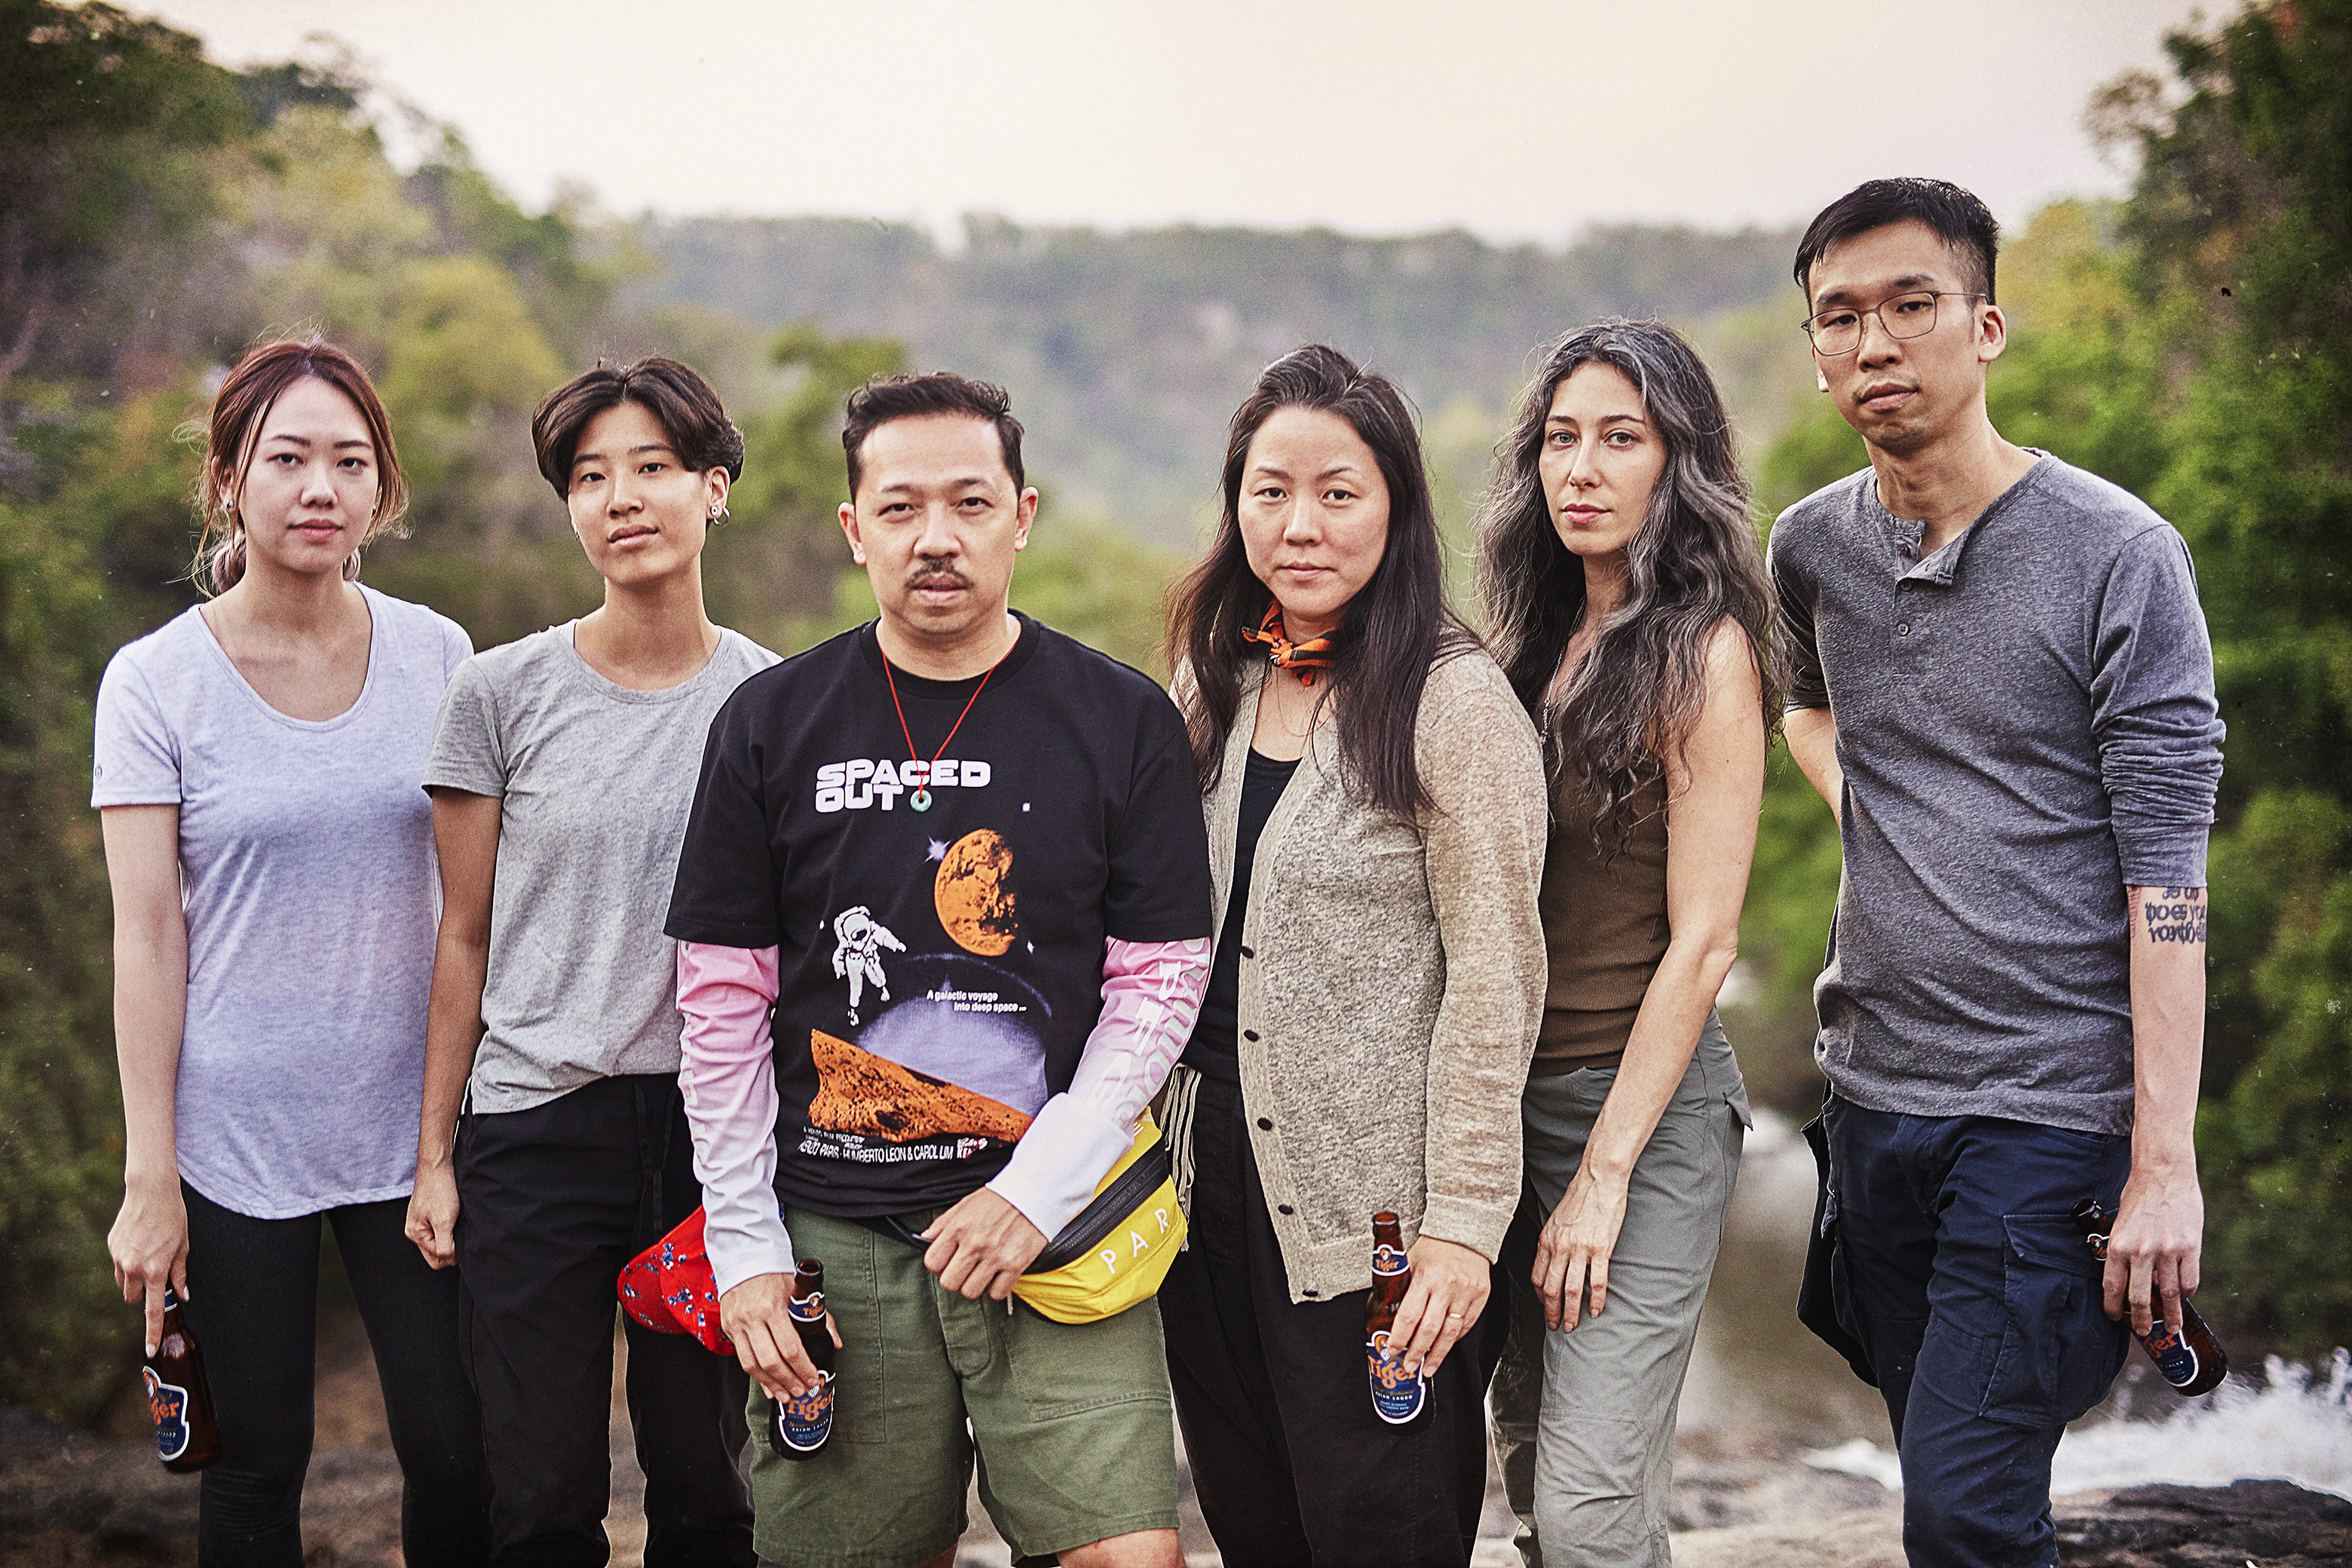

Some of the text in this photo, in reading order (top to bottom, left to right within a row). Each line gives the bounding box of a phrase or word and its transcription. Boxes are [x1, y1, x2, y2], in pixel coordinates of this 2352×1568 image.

[816, 758, 991, 790] SPACED
[815, 782, 904, 813] OUT
[926, 989, 999, 1003] A galactic voyage
[954, 1002, 970, 1012] into
[971, 1002, 992, 1013] deep
[993, 1003, 1018, 1013] space
[885, 1147, 906, 1163] LEON
[907, 1146, 914, 1162] &
[914, 1144, 939, 1161] CAROL
[939, 1145, 954, 1161] LIM
[1099, 1208, 1169, 1274] PAR
